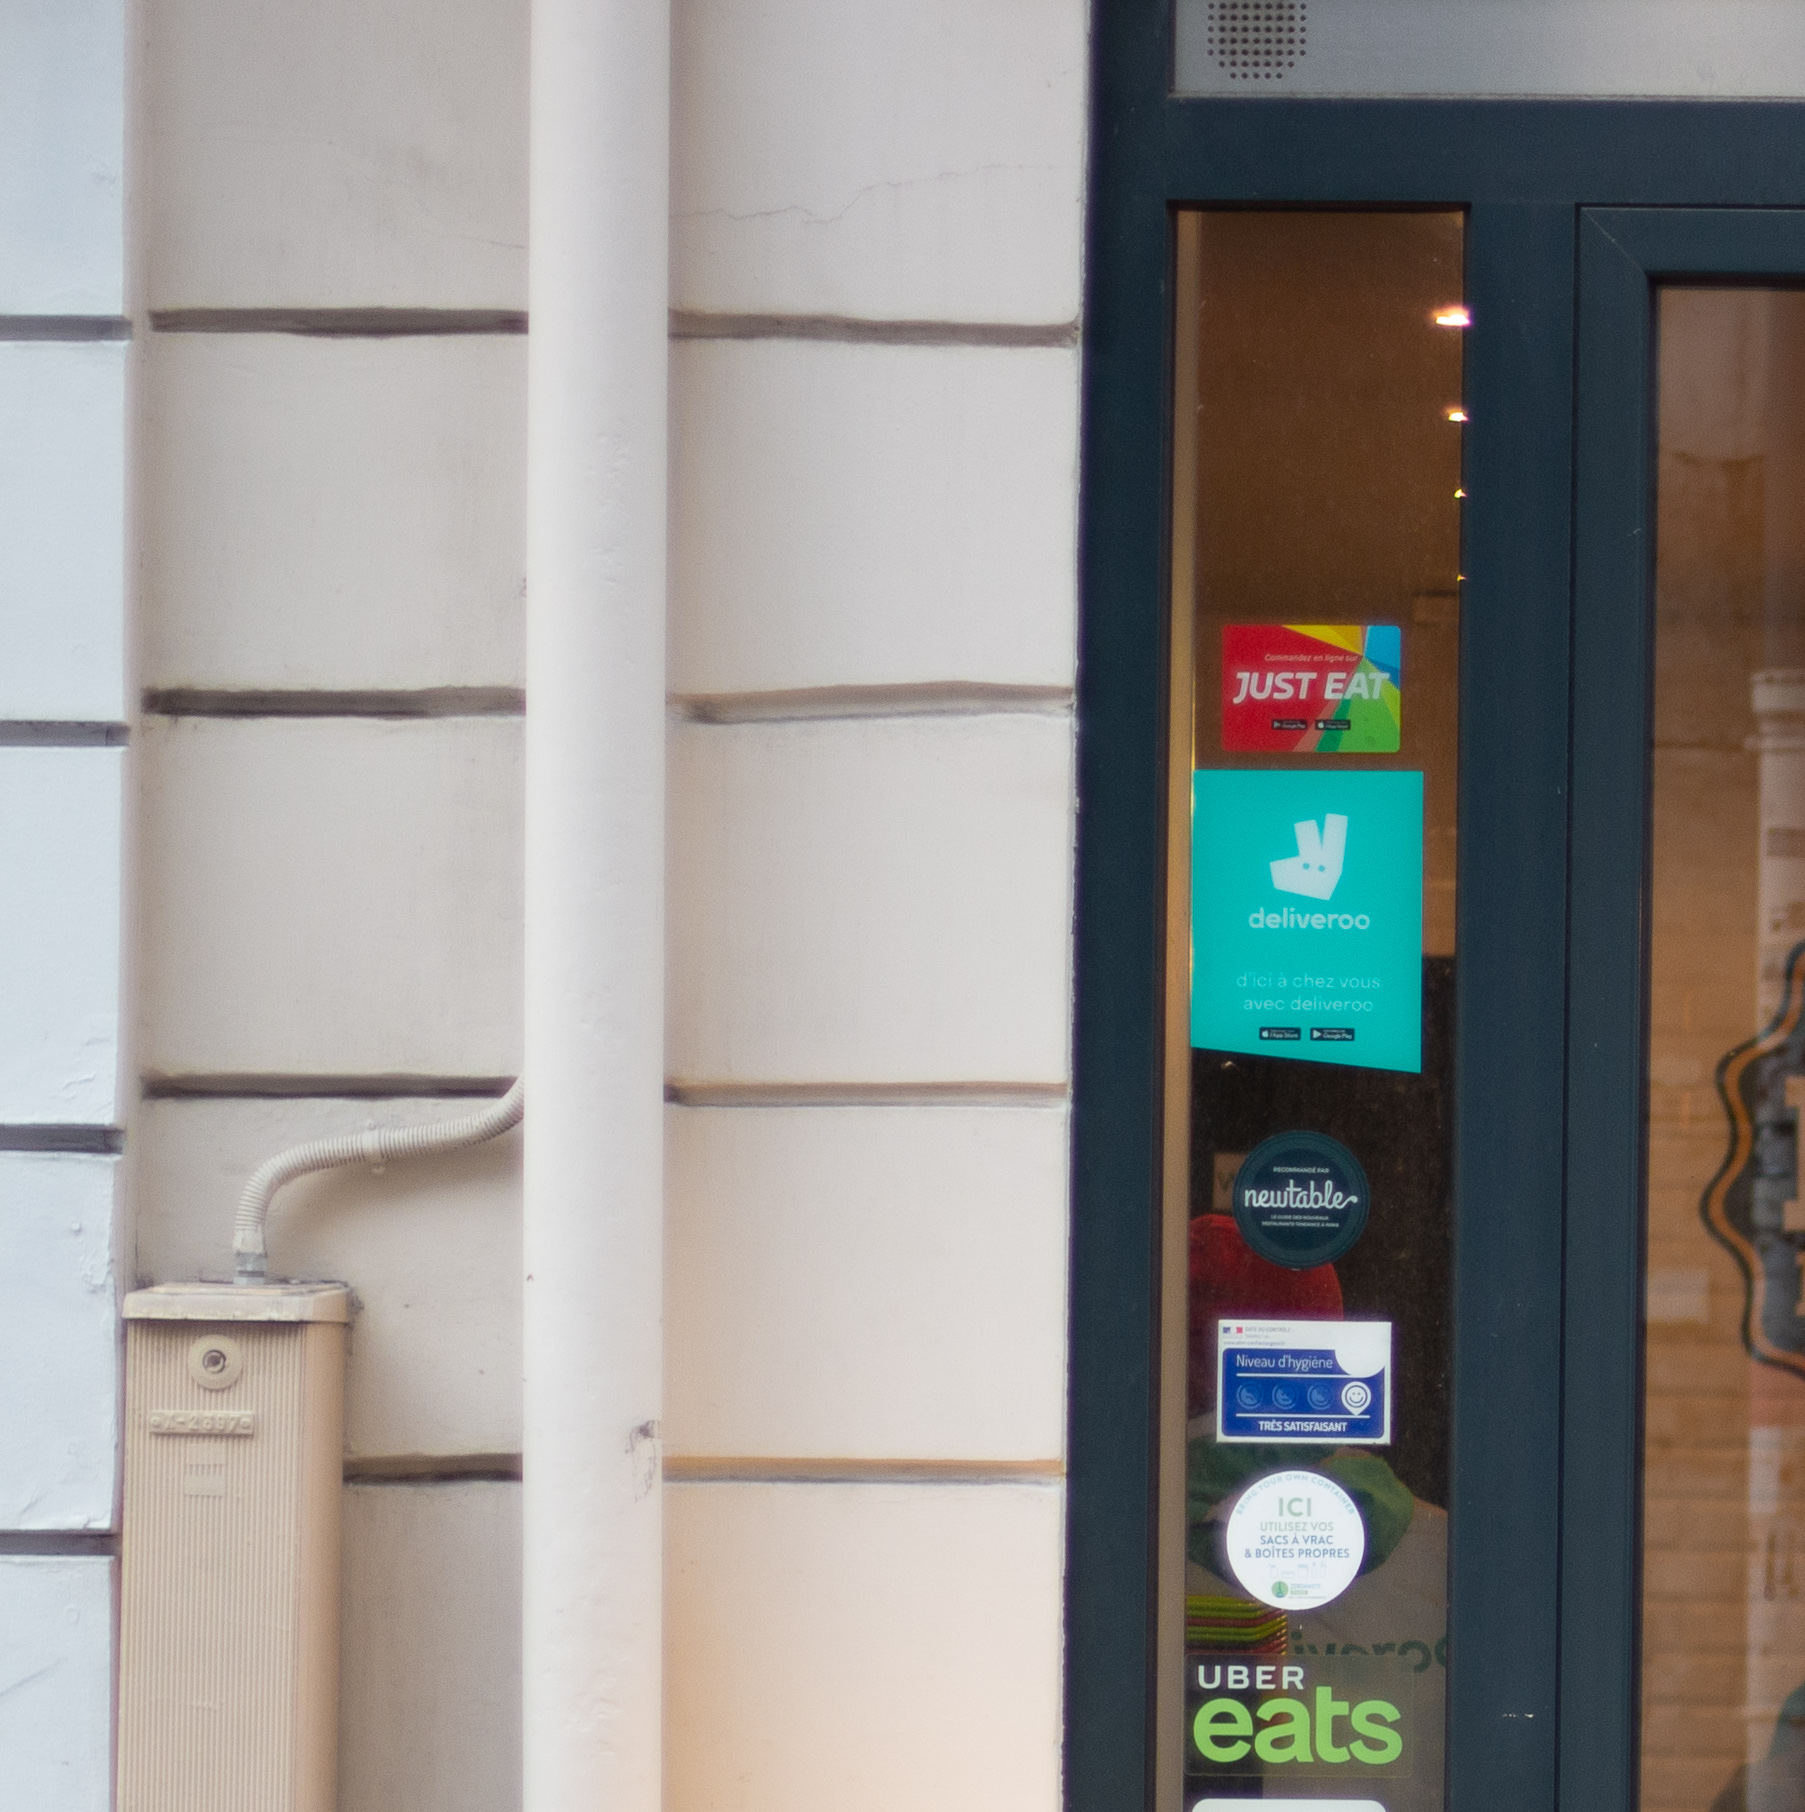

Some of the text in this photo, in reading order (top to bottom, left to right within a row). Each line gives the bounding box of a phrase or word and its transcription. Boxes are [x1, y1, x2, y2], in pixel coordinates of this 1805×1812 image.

[1233, 672, 1390, 704] JUST EAT
[1249, 909, 1370, 930] deliveroo
[1236, 972, 1380, 989] d'ici à chez vous
[1243, 997, 1373, 1013] avec deliveroo
[1245, 1179, 1358, 1209] newtable
[1236, 1355, 1333, 1371] Niveau d'hygiène
[1259, 1420, 1347, 1432] TRÈS SATISFAISANT
[1235, 1489, 1258, 1515] BRING
[1259, 1476, 1282, 1490] YOUR
[1311, 1477, 1354, 1514] CONTAINER
[1279, 1498, 1311, 1517] ICI
[1260, 1522, 1334, 1532] UTILISEZ VOS
[1260, 1533, 1333, 1544] SACS À VRAC
[1245, 1546, 1349, 1558] & BOÎTES PROPRES
[1198, 1665, 1304, 1690] UBER
[1192, 1686, 1403, 1765] eats
